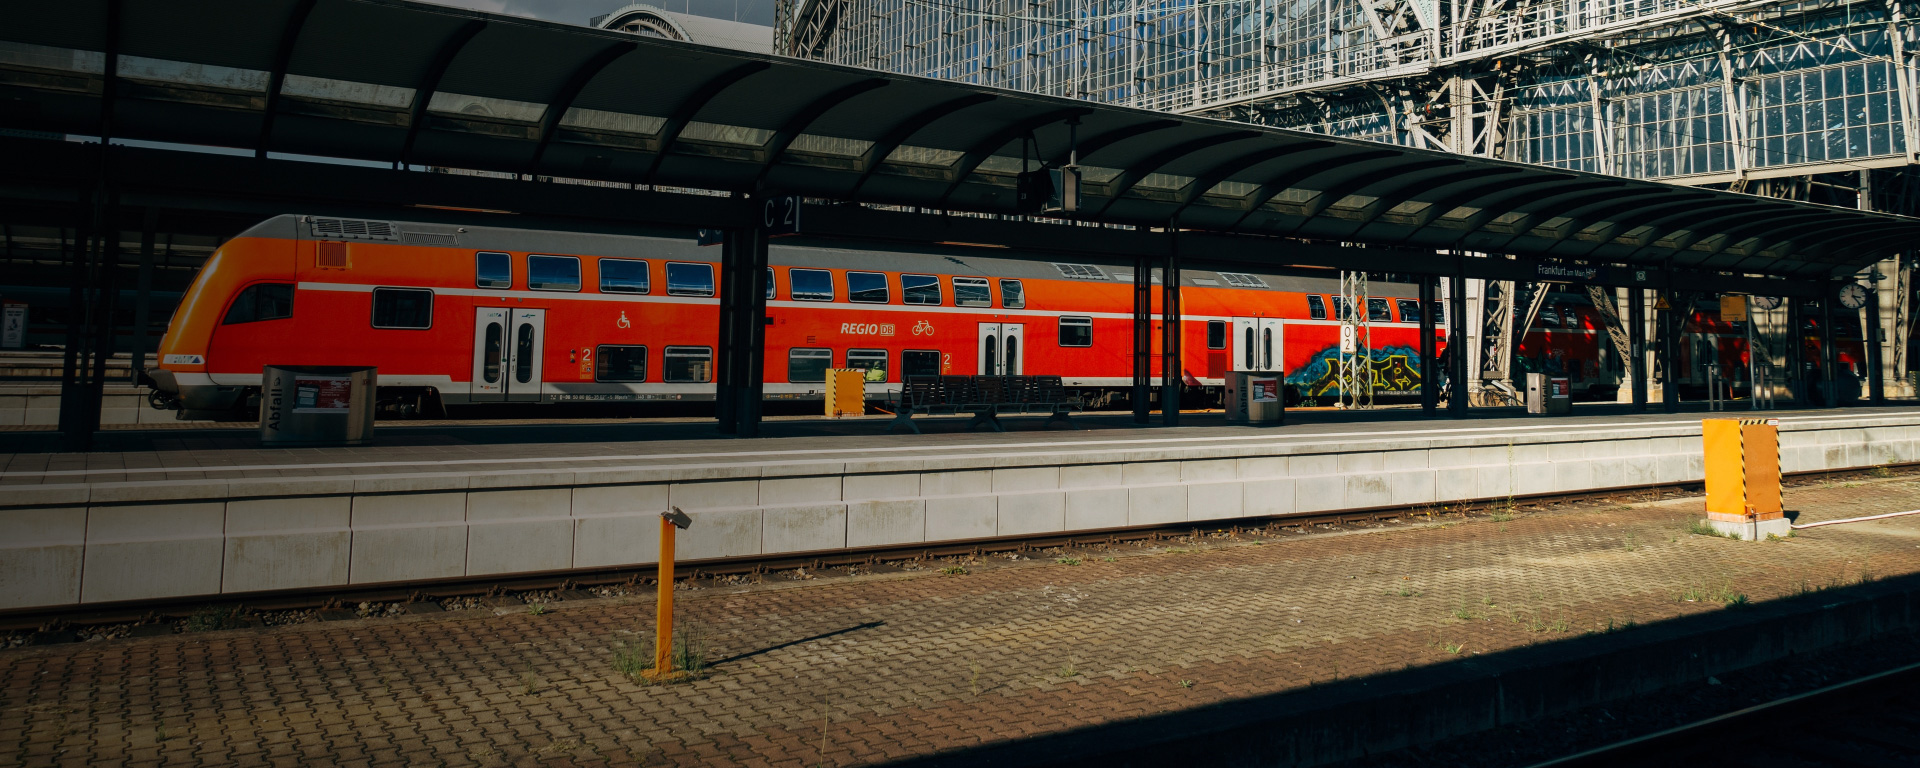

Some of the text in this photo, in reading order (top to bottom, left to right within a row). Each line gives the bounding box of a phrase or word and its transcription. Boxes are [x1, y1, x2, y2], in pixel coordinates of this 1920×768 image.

[764, 196, 794, 228] C 2
[1538, 264, 1567, 276] Frankfurt
[1574, 269, 1586, 277] Main
[840, 322, 894, 335] REGIO DB
[582, 348, 591, 361] 2
[943, 353, 951, 365] 2
[268, 388, 283, 431] Abfall
